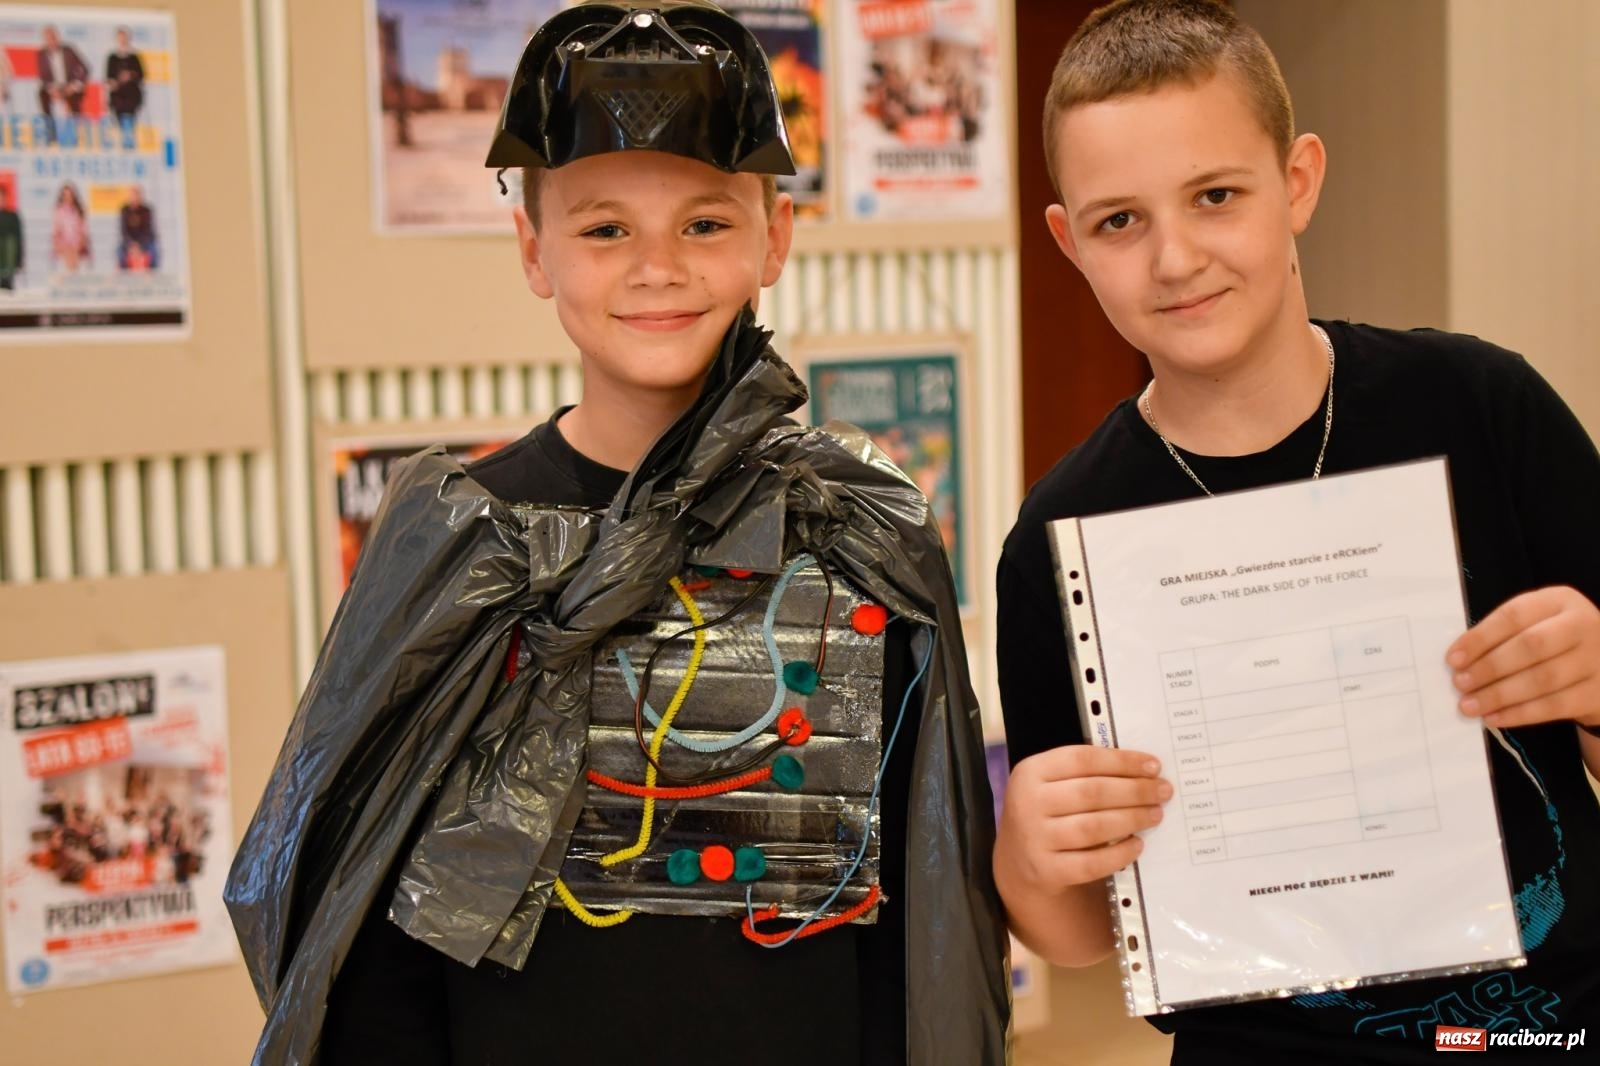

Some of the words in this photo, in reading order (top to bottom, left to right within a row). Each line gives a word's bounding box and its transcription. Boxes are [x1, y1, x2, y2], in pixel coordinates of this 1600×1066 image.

[1160, 575, 1183, 587] GRA
[1184, 568, 1228, 582] MIEJSKA
[1288, 553, 1323, 568] starcie
[1324, 553, 1331, 562] z
[1180, 592, 1220, 607] GRUPA:
[1221, 588, 1241, 600] THE
[1243, 583, 1271, 597] DARK
[1272, 580, 1296, 593] SIDE
[1297, 577, 1312, 588] OF
[1313, 573, 1334, 585] THE
[1336, 568, 1369, 582] FORCE
[1166, 668, 1194, 680] NUMER
[1249, 885, 1282, 897] NIECH
[1284, 882, 1307, 893] MOC
[1309, 876, 1348, 889] BĘDZIE
[1350, 874, 1357, 882] Z
[1359, 869, 1395, 882] WAMI!
